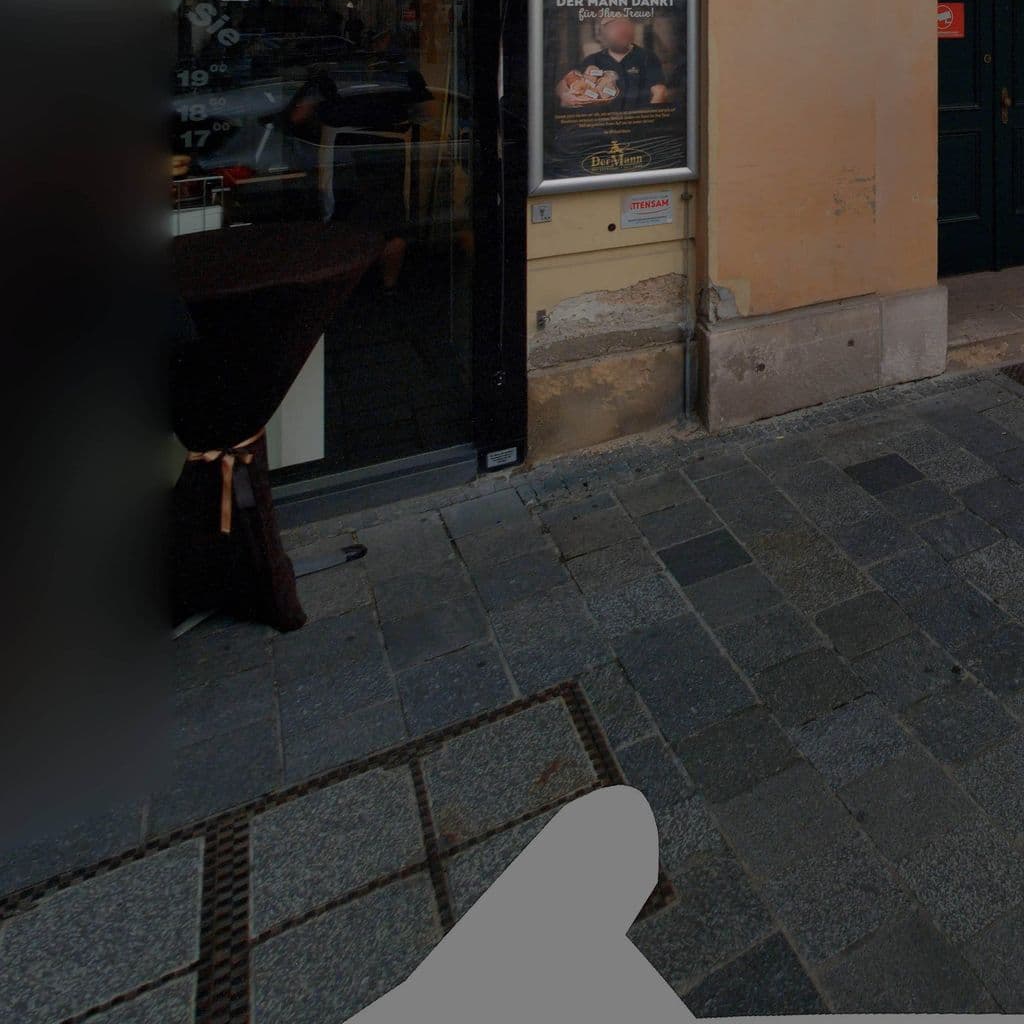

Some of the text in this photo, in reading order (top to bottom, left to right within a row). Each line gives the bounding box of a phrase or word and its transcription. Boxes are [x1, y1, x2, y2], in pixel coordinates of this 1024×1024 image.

[187, 2, 241, 47] Sie
[578, 8, 597, 21] für
[598, 7, 622, 18] Ihre
